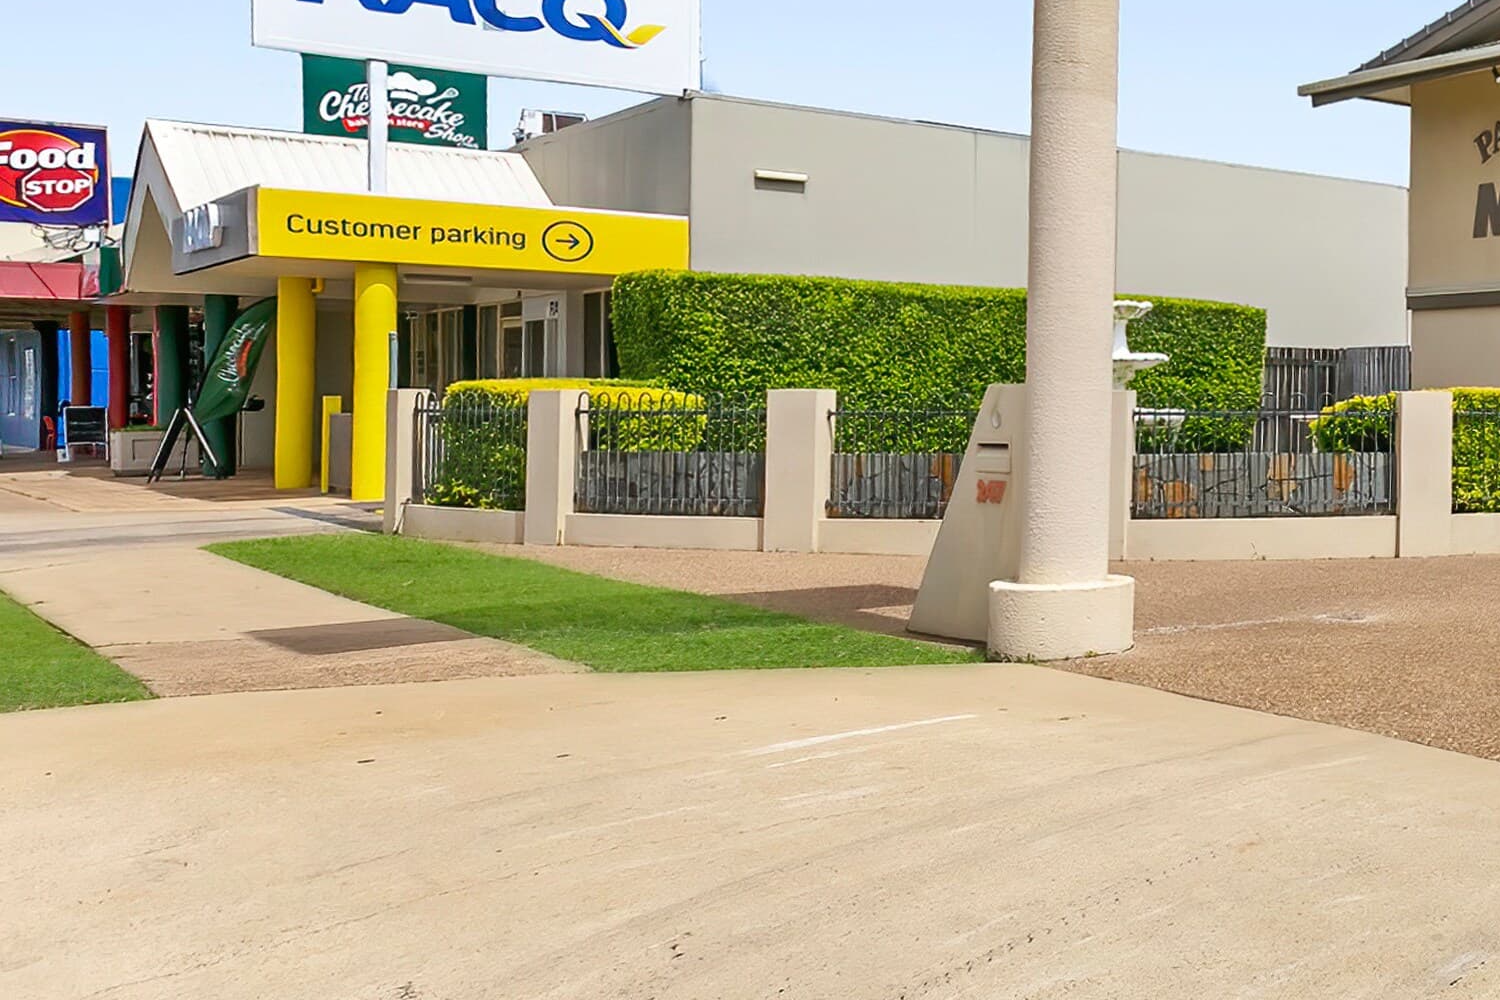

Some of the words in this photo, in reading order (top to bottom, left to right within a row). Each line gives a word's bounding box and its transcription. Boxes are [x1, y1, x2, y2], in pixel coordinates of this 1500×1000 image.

[348, 82, 369, 102] Th
[319, 90, 465, 127] Chesecake
[423, 123, 475, 147] Shop
[25, 179, 92, 197] STOP
[286, 213, 422, 240] Customer
[430, 226, 527, 250] parking
